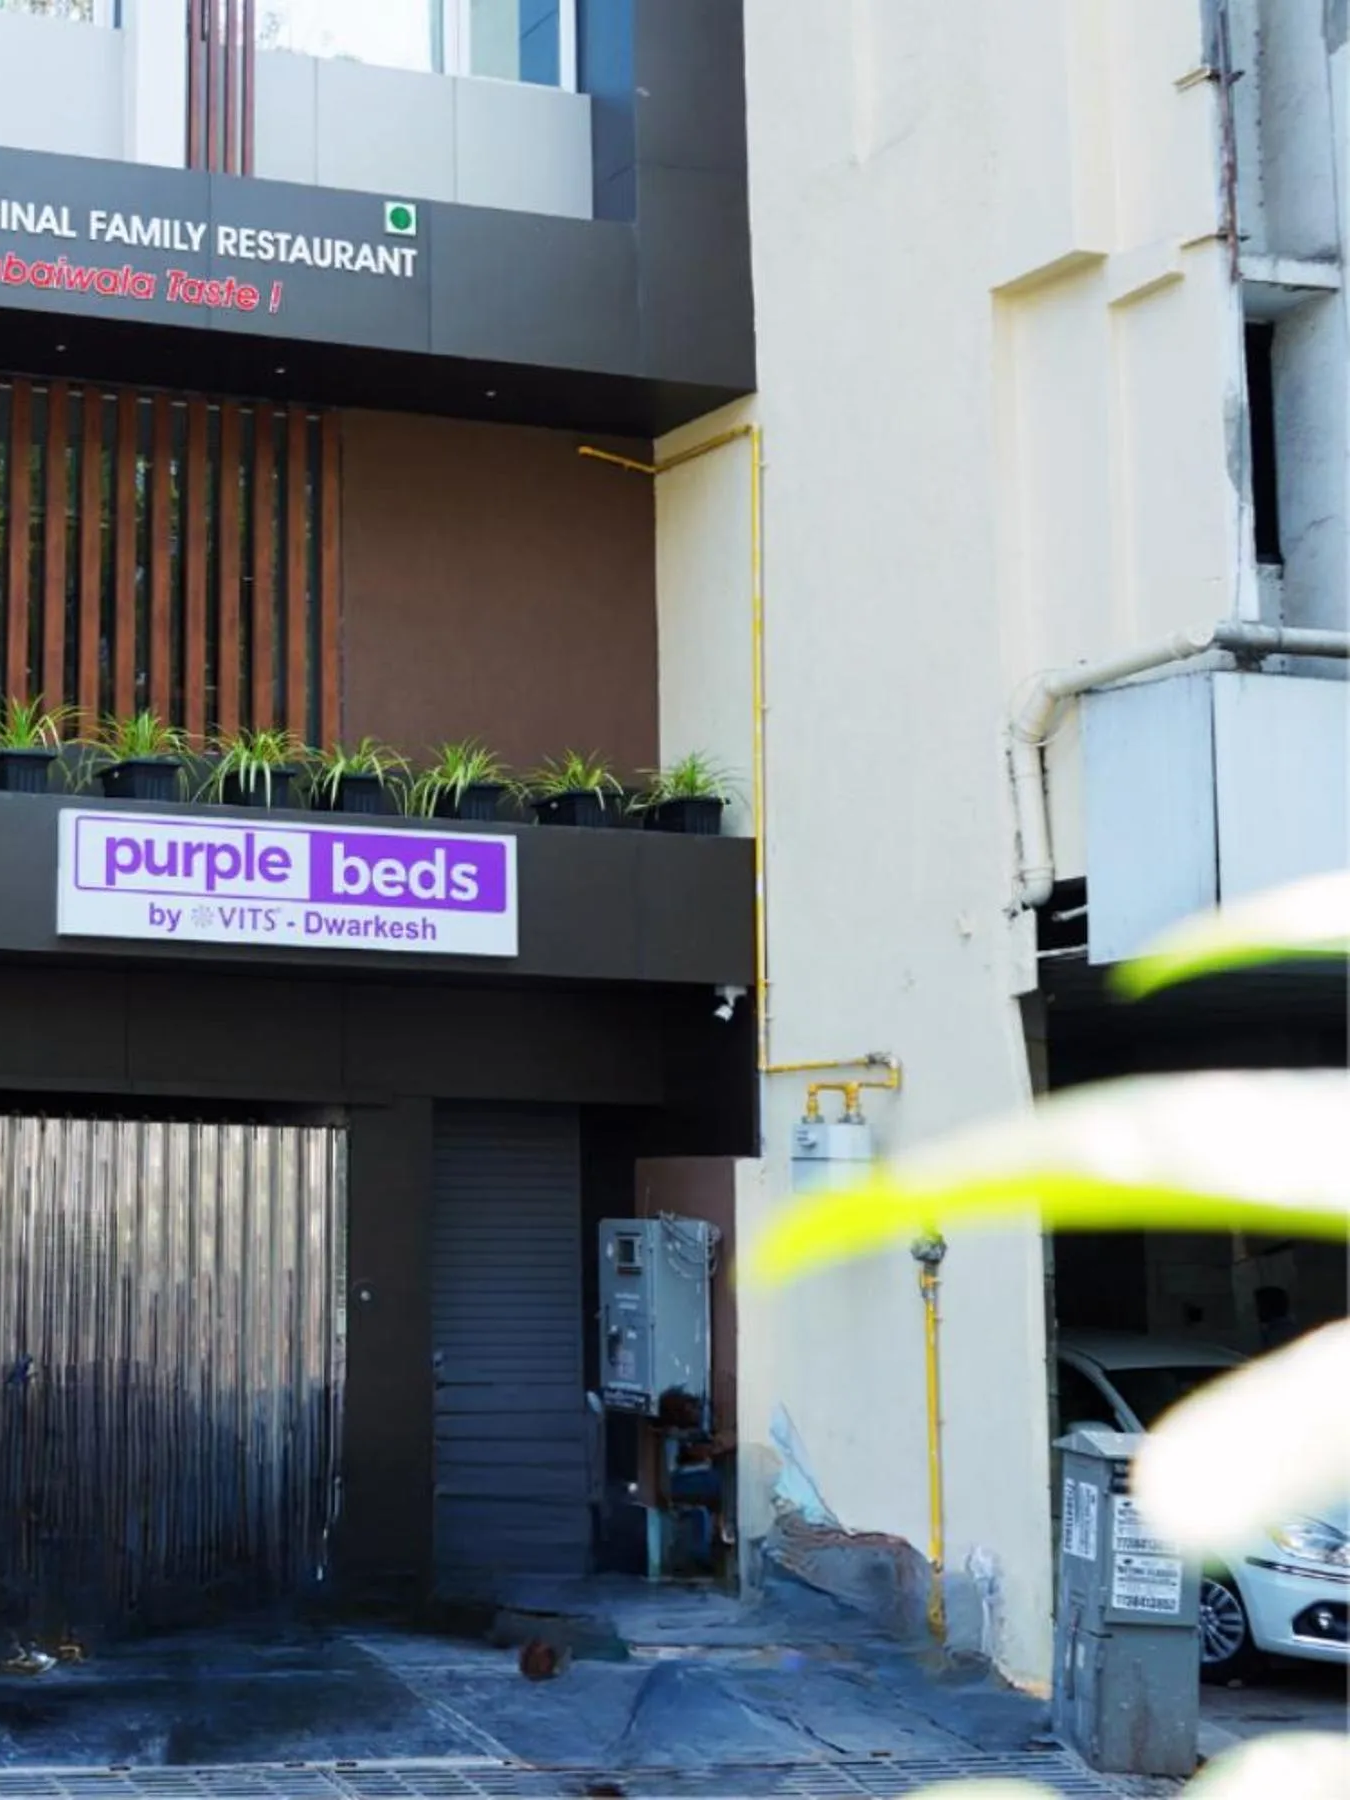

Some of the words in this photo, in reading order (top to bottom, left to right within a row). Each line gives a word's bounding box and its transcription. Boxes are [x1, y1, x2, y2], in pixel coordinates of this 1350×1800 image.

[89, 210, 207, 252] FAMILY
[217, 226, 418, 277] RESTAURANT
[165, 269, 259, 313] Taste
[104, 832, 292, 891] purple
[331, 841, 480, 902] beds
[148, 903, 182, 933] by
[219, 906, 278, 932] VITS
[304, 911, 437, 941] Dwarkesh
